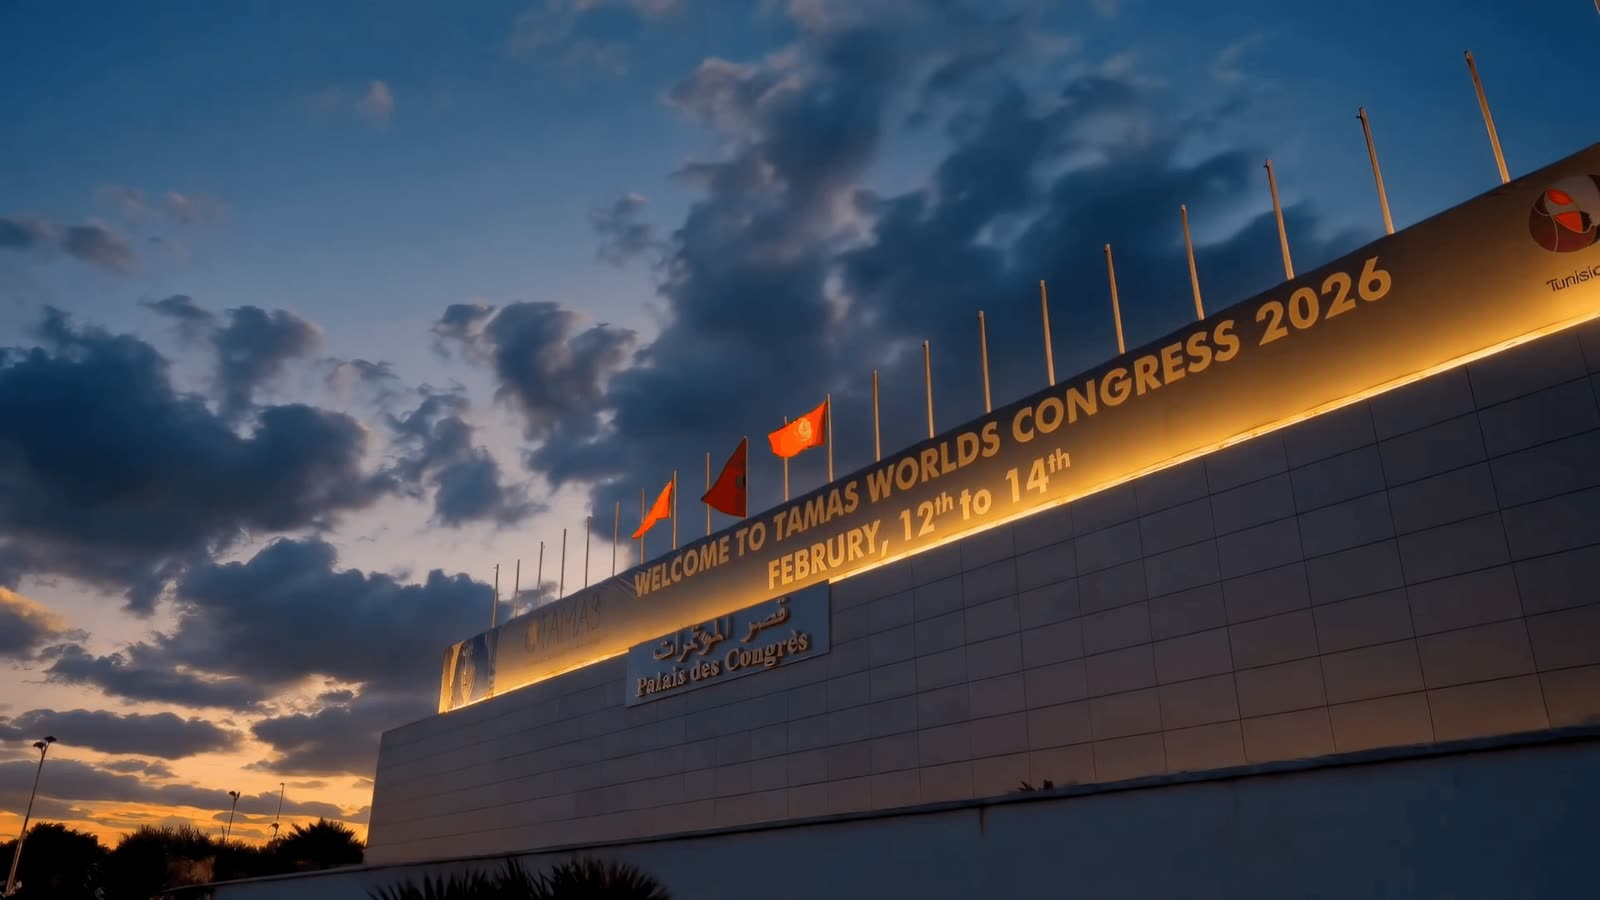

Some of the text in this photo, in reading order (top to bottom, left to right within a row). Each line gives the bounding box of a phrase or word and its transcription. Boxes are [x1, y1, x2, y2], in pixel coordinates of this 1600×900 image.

[635, 256, 1392, 598] WELCOME TO TAMAS WORLDS CONGRESS 2026
[768, 448, 1071, 591] FEBRURY, 12th to 14th
[635, 629, 809, 697] Palais des Congrès
[740, 598, 789, 643] قصر
